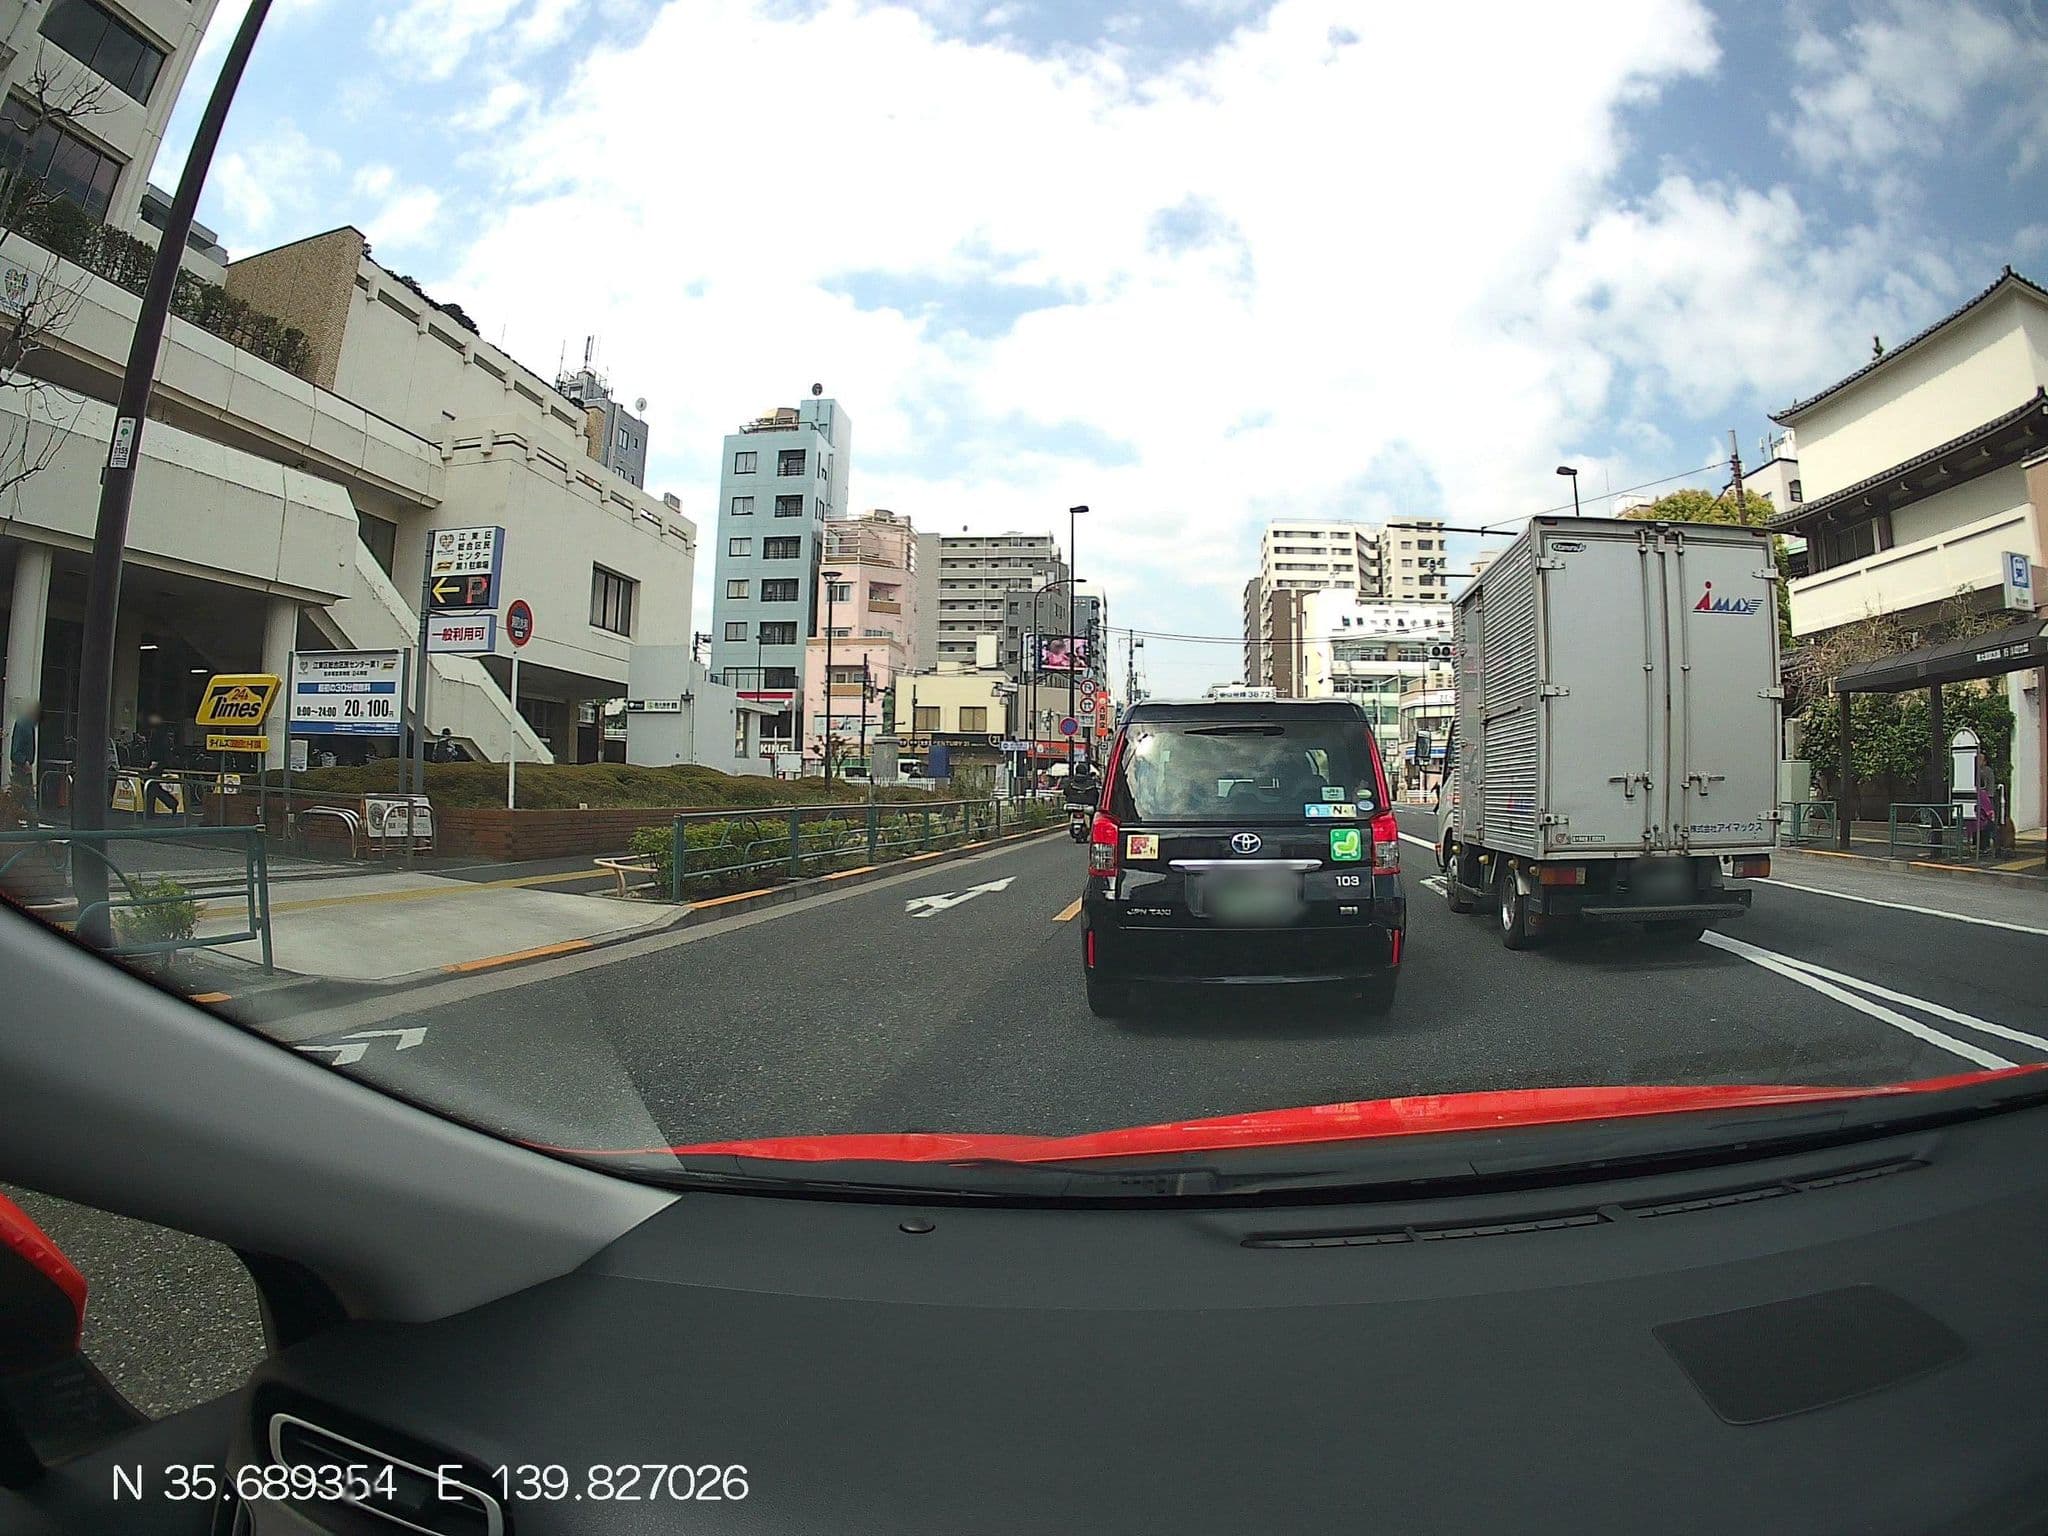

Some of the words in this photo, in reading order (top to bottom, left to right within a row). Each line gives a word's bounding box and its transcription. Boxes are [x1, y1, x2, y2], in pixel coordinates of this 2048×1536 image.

[459, 531, 492, 541] 江東区
[458, 541, 491, 551] 総合区民
[457, 552, 490, 560] センター
[432, 627, 485, 641] 一般利用可
[209, 696, 262, 719] Times
[1690, 822, 1763, 833] 株式会社アイマックス
[1335, 876, 1360, 886] 103
